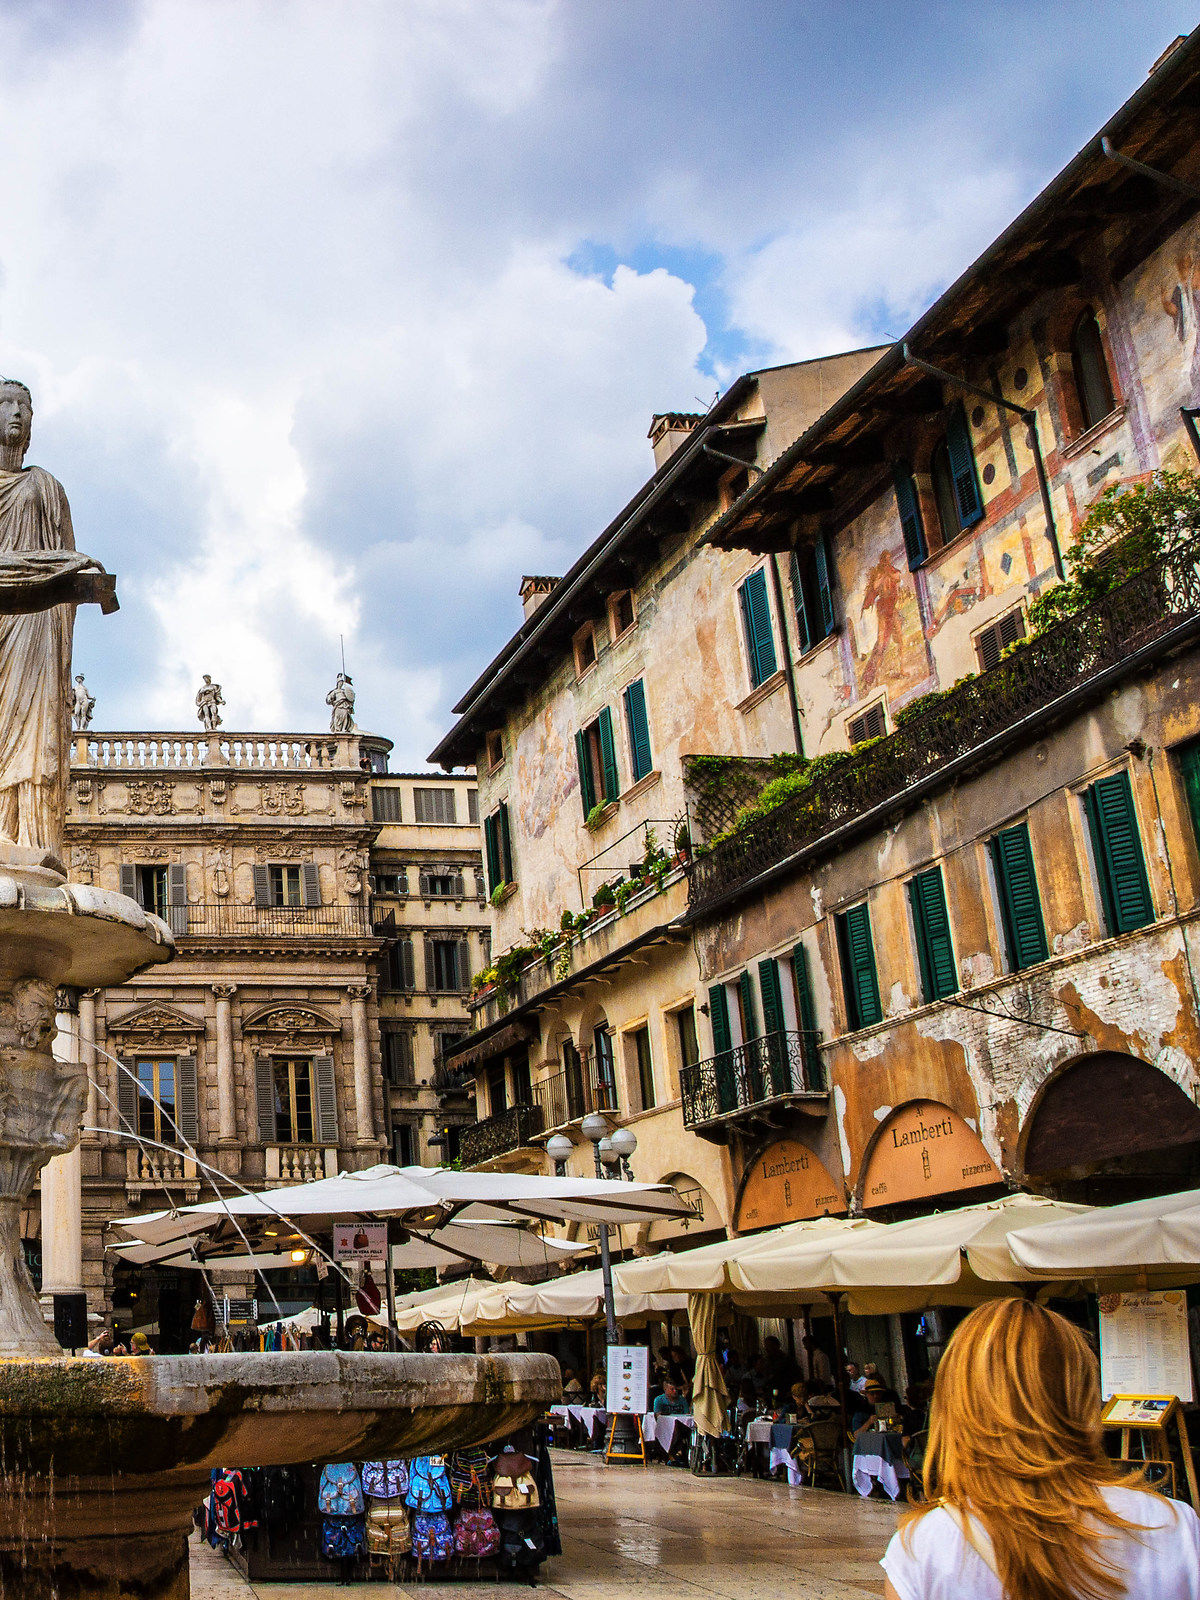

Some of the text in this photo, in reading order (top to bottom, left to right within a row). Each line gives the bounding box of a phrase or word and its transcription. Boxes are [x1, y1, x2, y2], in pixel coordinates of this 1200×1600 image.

[891, 1117, 954, 1148] Lamberti
[762, 1152, 809, 1179] Lamberti
[961, 1161, 992, 1179] pizzeria
